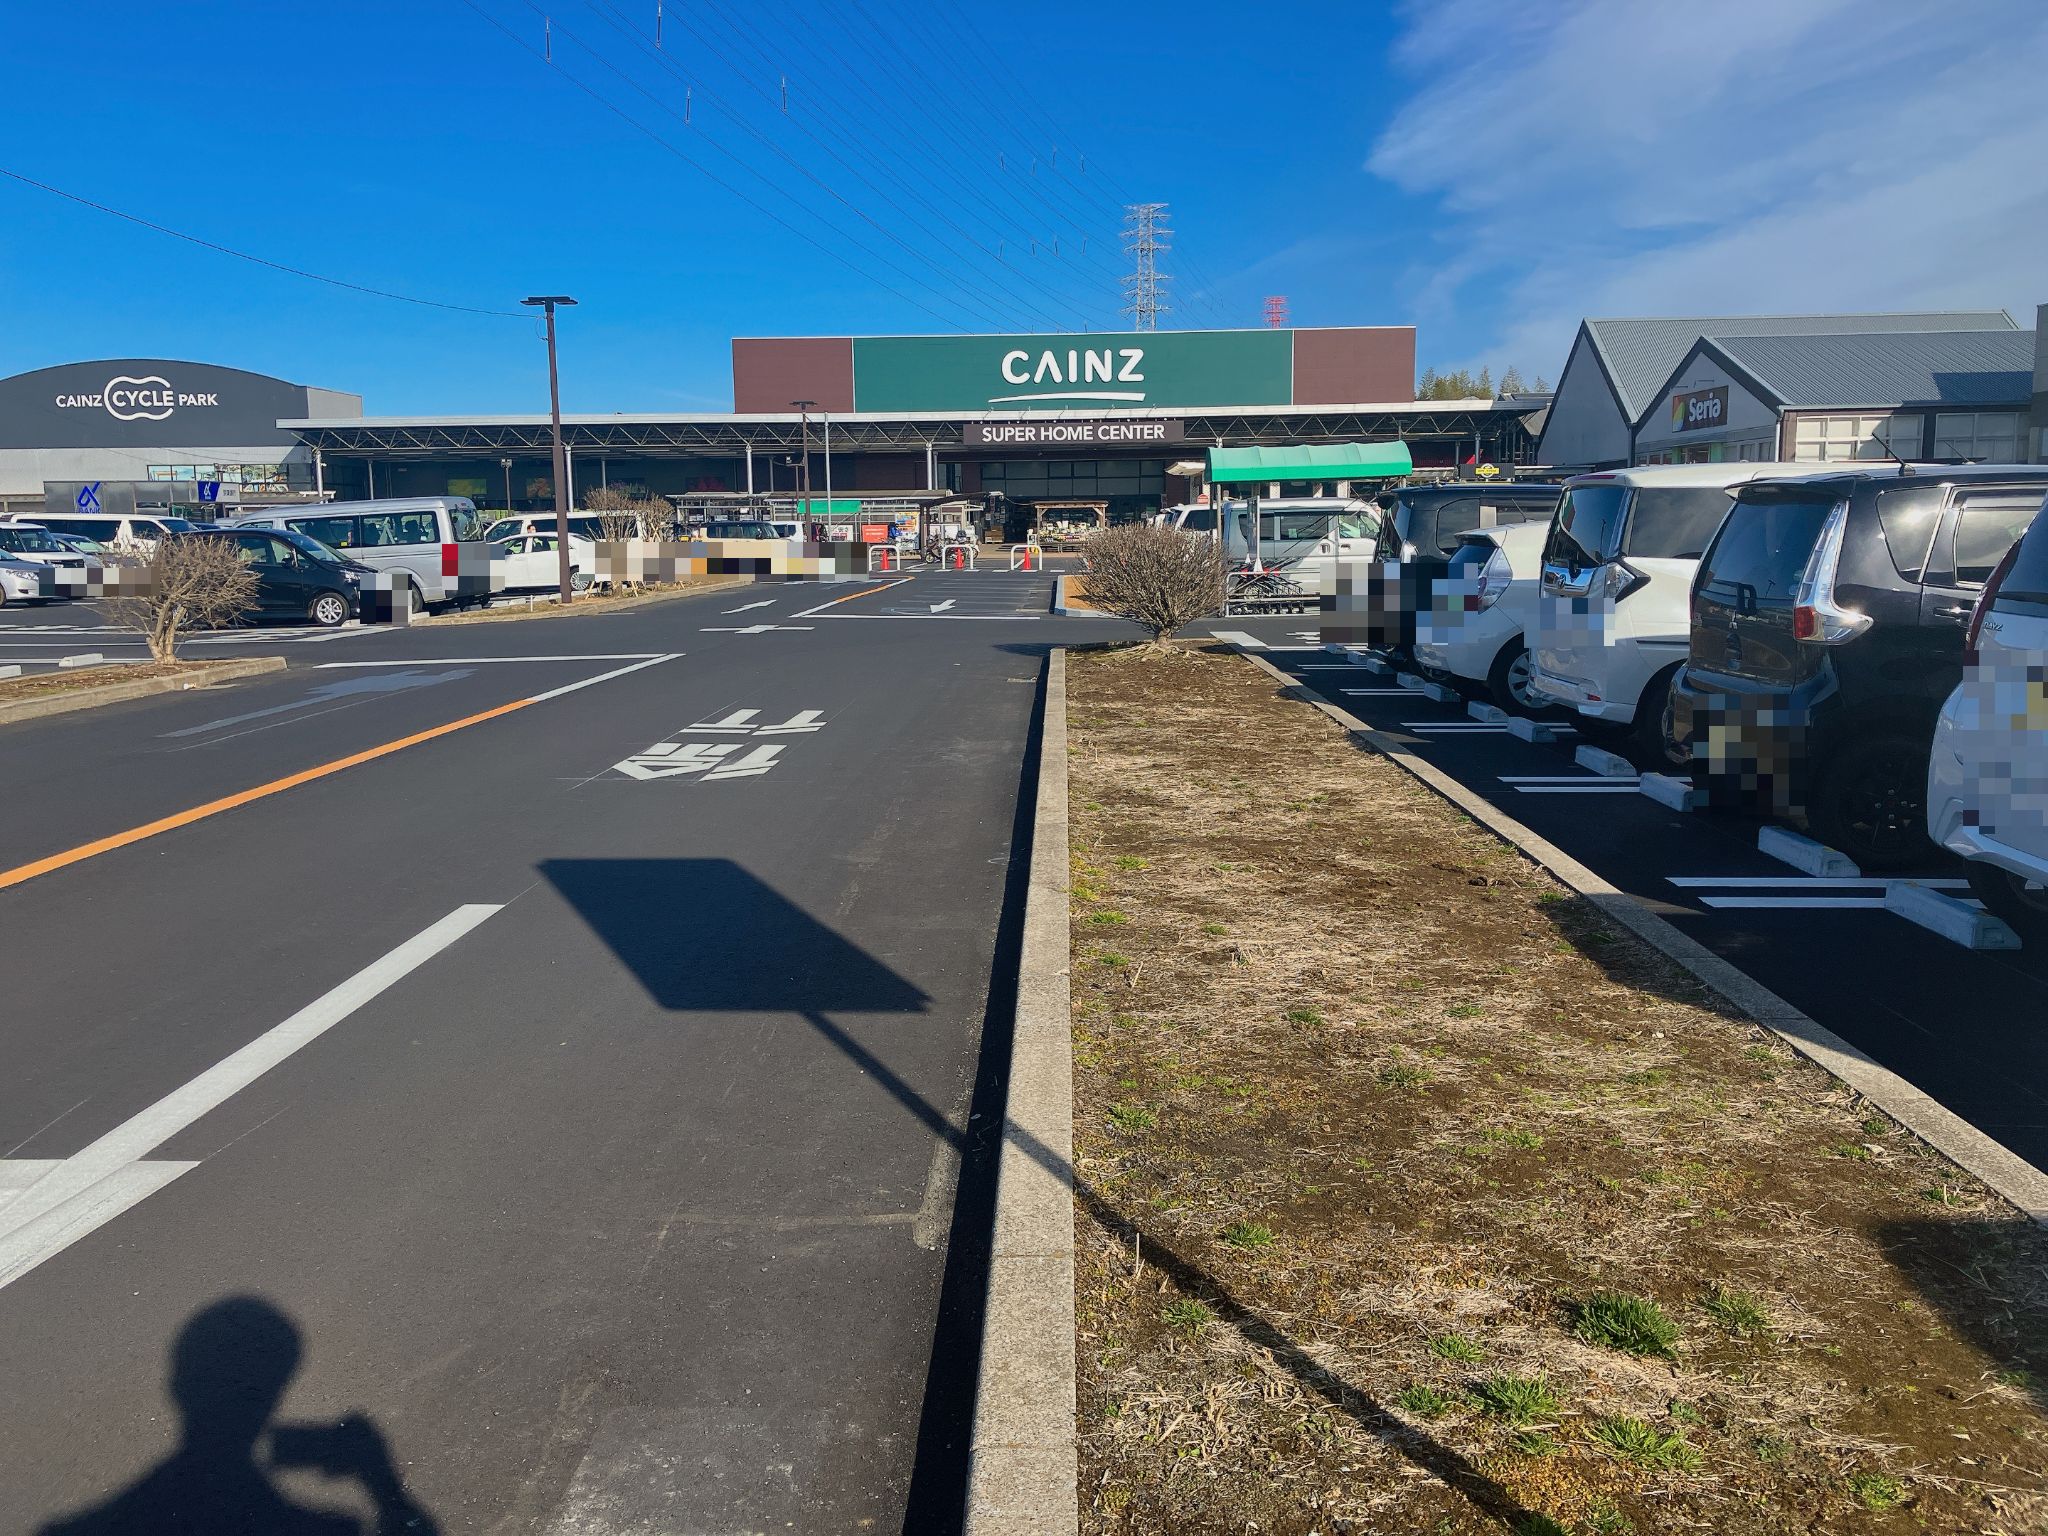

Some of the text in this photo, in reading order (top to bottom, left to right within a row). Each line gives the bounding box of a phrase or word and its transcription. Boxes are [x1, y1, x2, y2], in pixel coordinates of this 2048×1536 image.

[1002, 349, 1145, 384] CAINZ
[55, 390, 219, 407] CAINZ CYCLE PARK
[1689, 392, 1721, 422] Seria
[982, 424, 1165, 442] SUPER HOME CENTER
